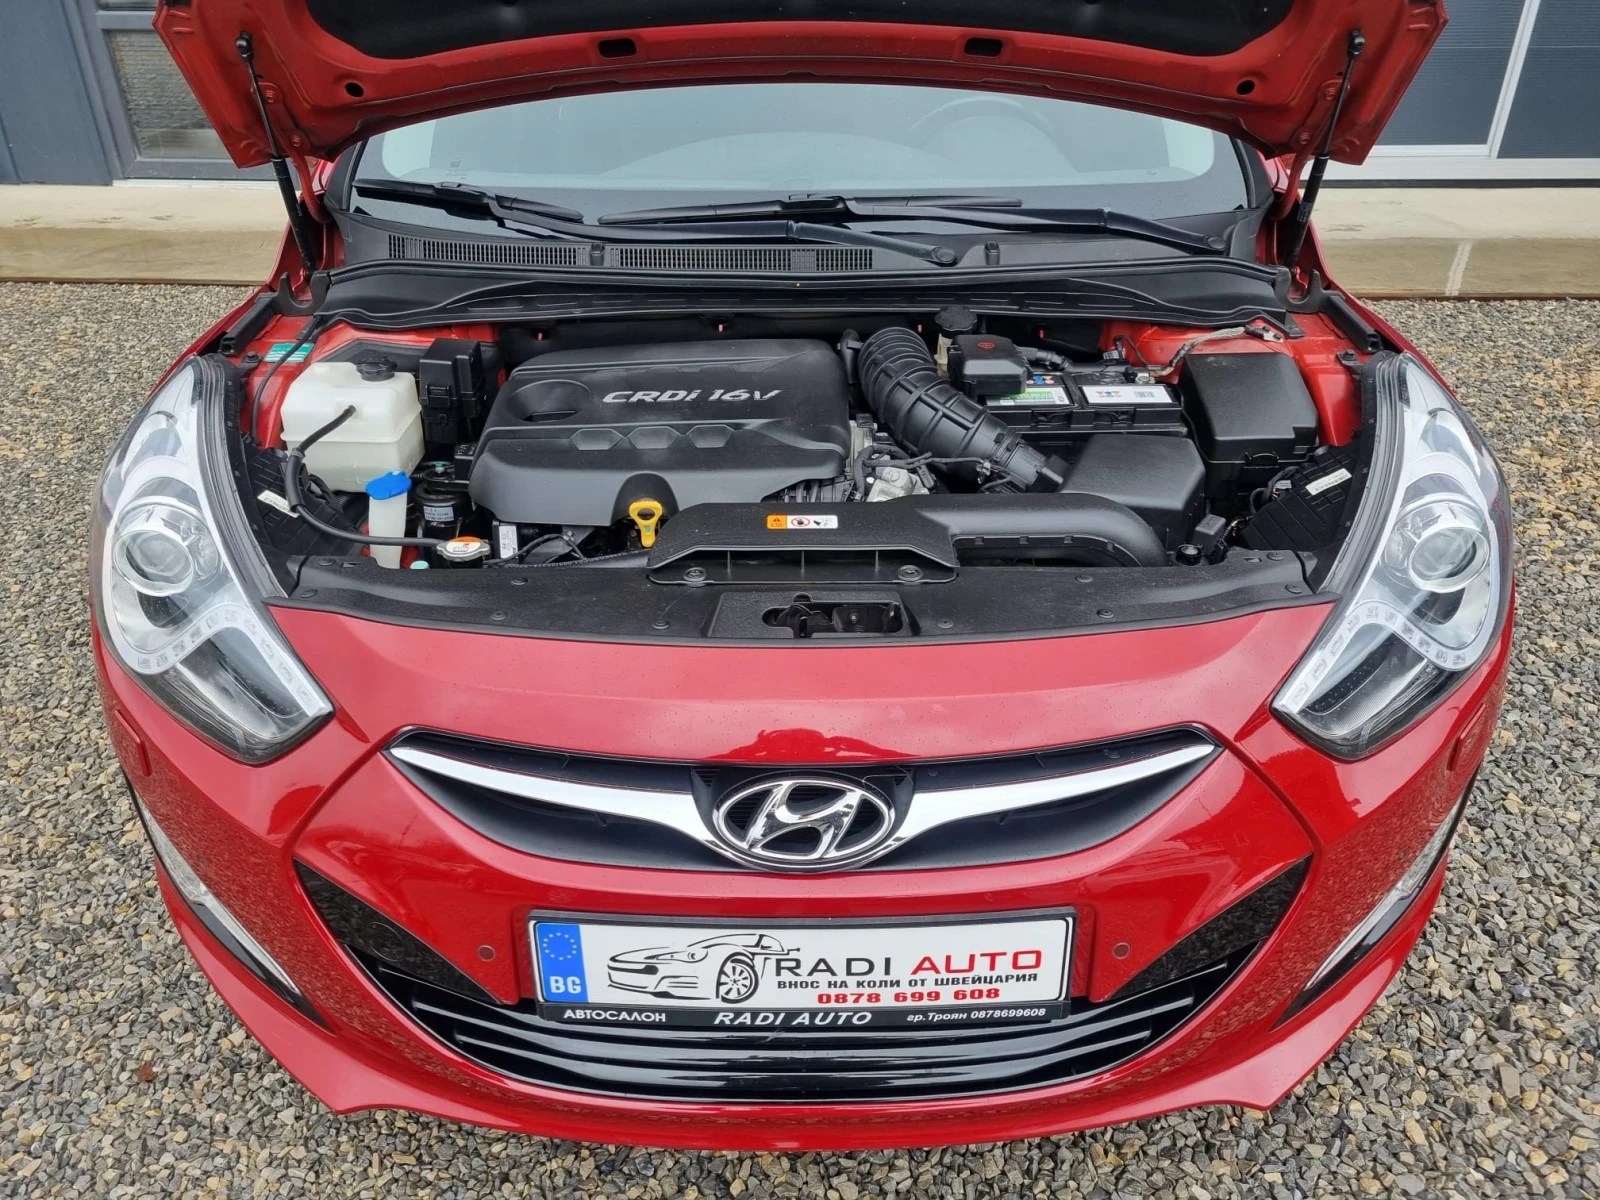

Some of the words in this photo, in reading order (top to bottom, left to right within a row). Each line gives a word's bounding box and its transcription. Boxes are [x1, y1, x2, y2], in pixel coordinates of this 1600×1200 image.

[602, 389, 702, 403] CRDi
[708, 389, 782, 401] 16V
[775, 957, 891, 976] RADI
[910, 950, 1042, 975] AUTO
[550, 975, 581, 994] BG
[777, 980, 820, 989] ВНОС
[827, 980, 849, 988] НА
[856, 979, 901, 988] КОЛИ
[908, 978, 927, 987] ОТ
[934, 973, 1038, 986] ШВЕЙЦАРИЯ
[817, 993, 881, 1004] 0878
[893, 991, 941, 1003] 699
[953, 988, 1000, 1000] 608
[563, 1009, 666, 1023] АВТОСАЛОН
[713, 1012, 786, 1026] RADI
[791, 1011, 872, 1025] AUTO
[970, 1008, 1047, 1019] 0878699608
